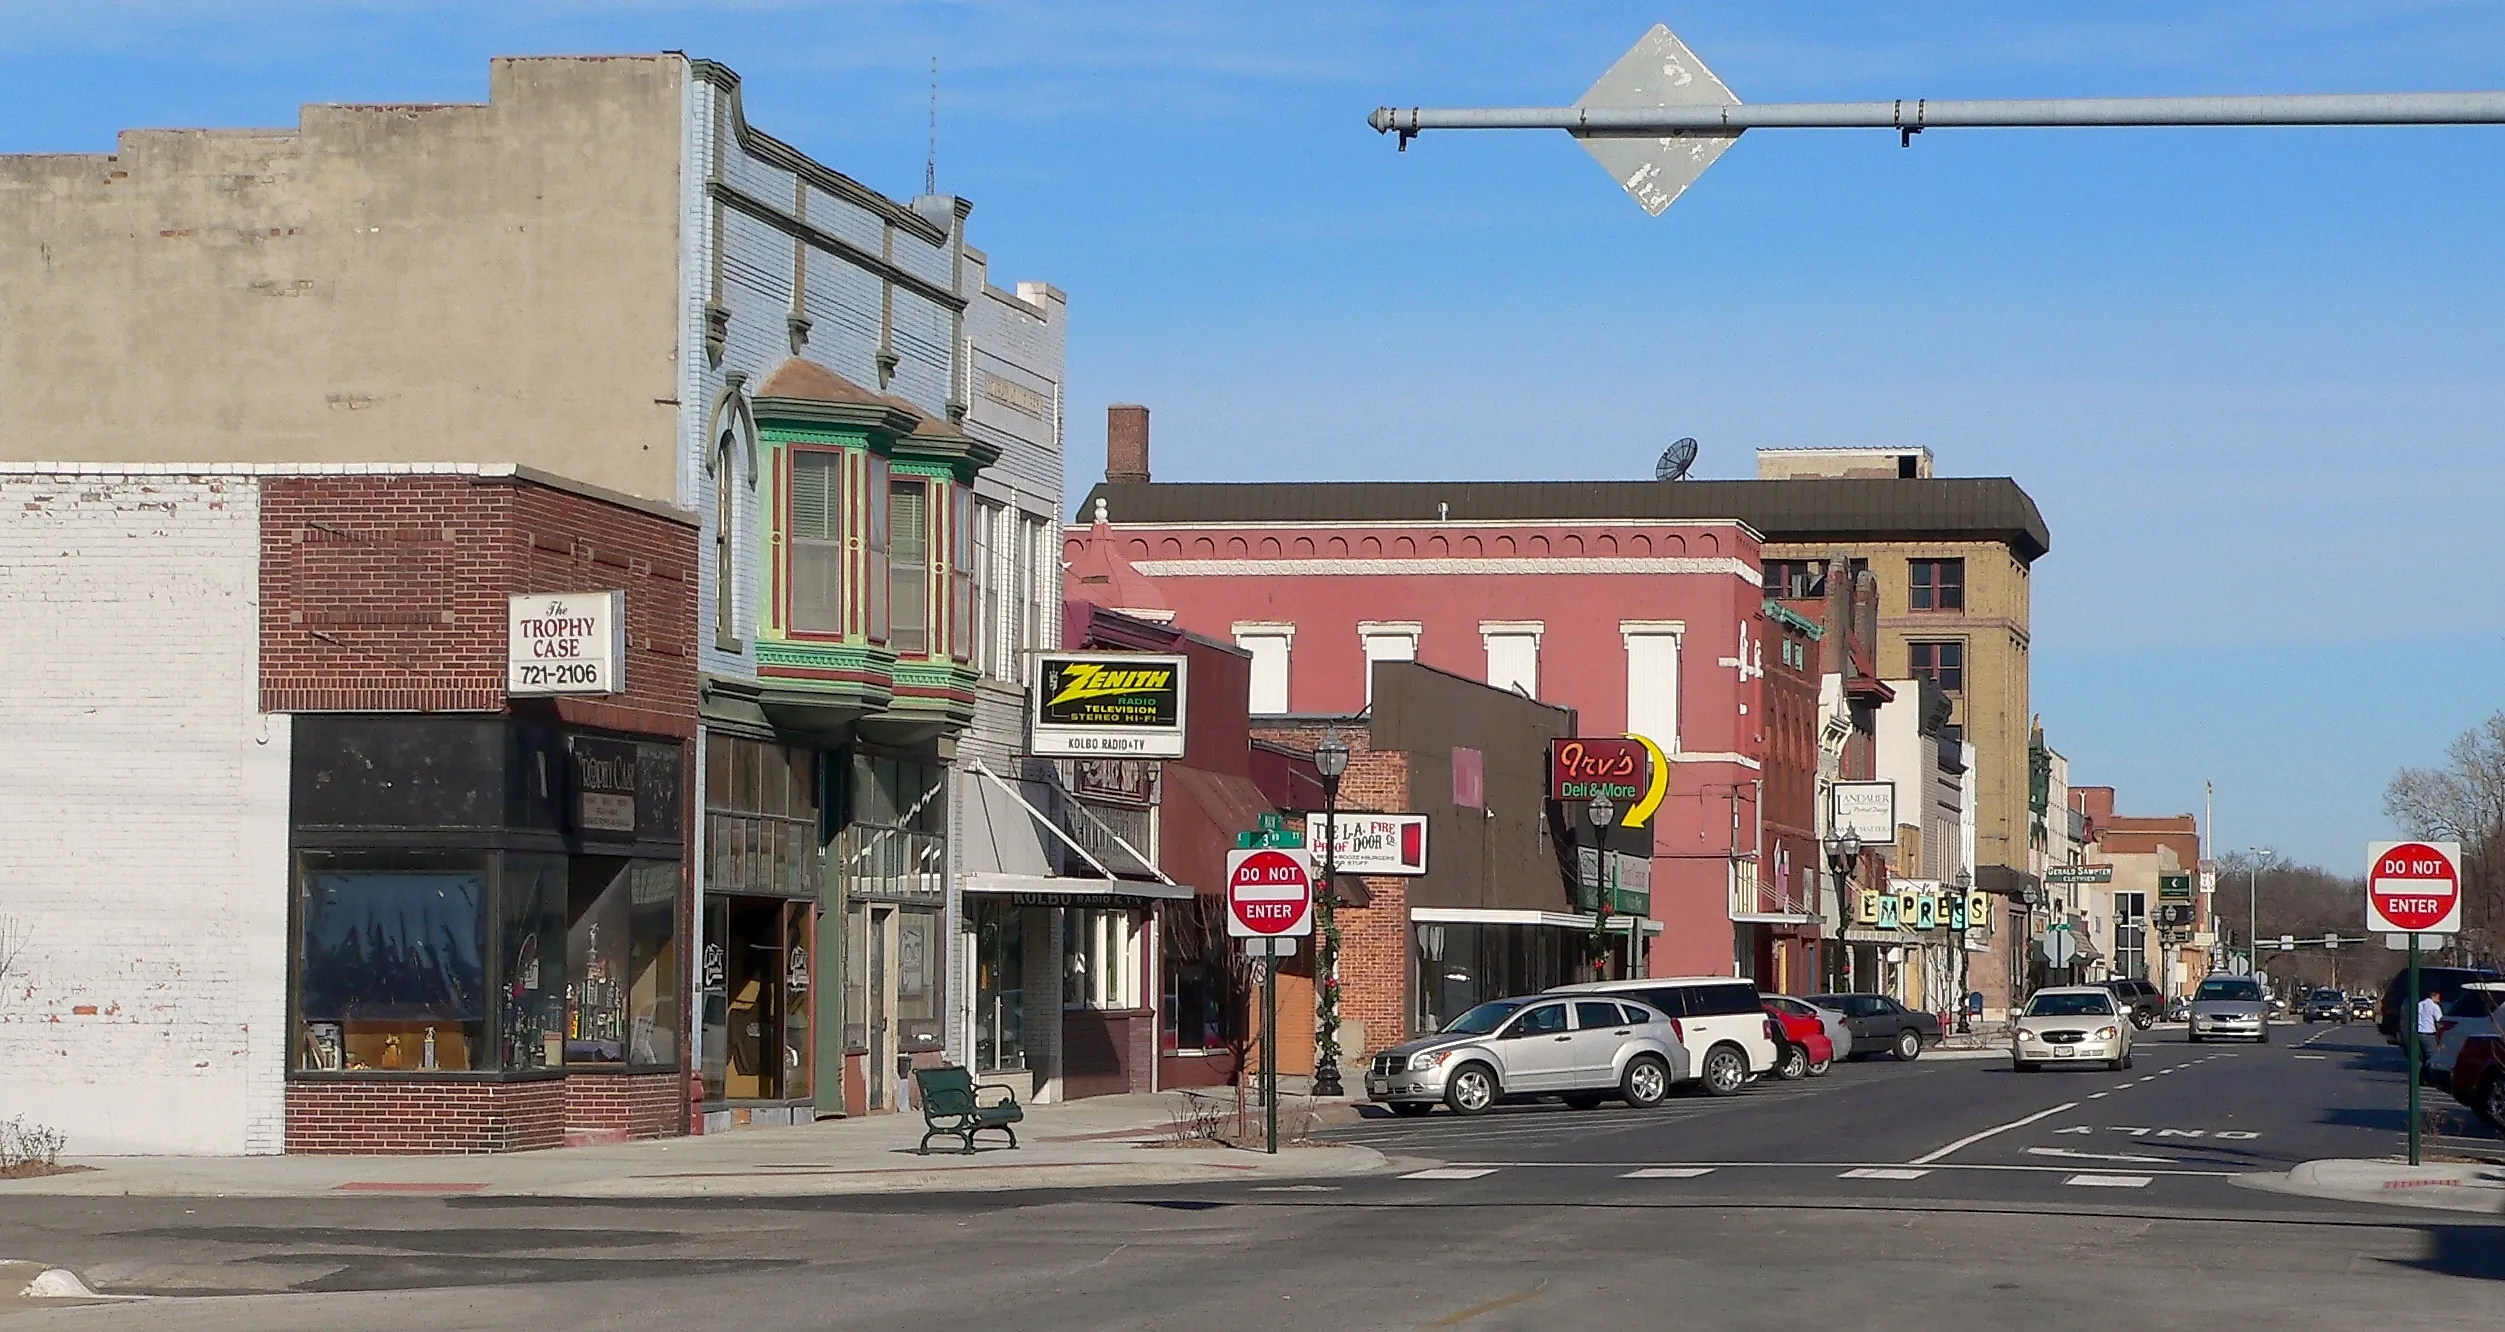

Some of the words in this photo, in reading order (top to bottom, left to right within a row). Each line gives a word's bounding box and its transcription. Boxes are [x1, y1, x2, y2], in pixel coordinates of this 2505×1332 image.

[545, 600, 568, 617] The
[520, 617, 595, 638] TROPHY
[533, 638, 580, 658] CASE
[520, 664, 598, 685] 721-2106
[1118, 697, 1157, 706] RADIO
[1084, 704, 1157, 715] TELEVISION
[1070, 713, 1120, 722] STEREO
[1068, 738, 1098, 750] KOLBO
[1561, 742, 1634, 777] Irv's
[1562, 782, 1588, 797] Deli
[1602, 782, 1636, 798] More
[1370, 821, 1396, 835] FIRE
[1313, 838, 1349, 853] PROF
[1352, 834, 1382, 852] DOOR
[1240, 867, 1260, 881] DO
[1269, 866, 1298, 881] NOT
[2385, 861, 2406, 875] DO
[2413, 860, 2443, 875] NOT
[1076, 894, 1111, 905] RADIO
[2389, 899, 2439, 914] ENTER
[1246, 904, 1292, 919] ENTER
